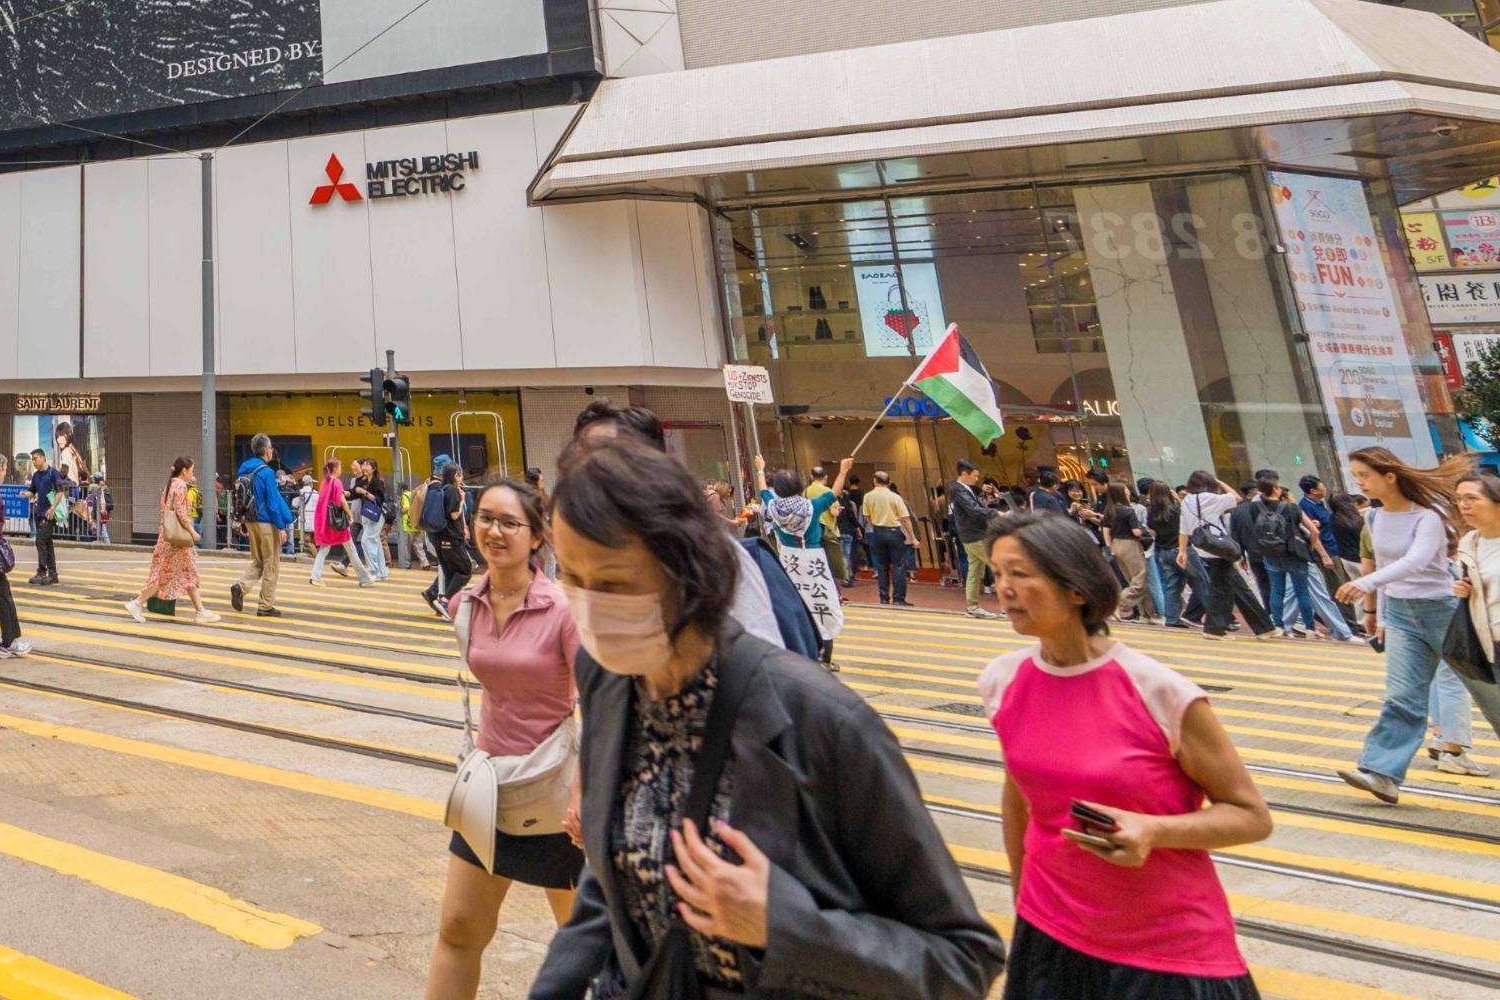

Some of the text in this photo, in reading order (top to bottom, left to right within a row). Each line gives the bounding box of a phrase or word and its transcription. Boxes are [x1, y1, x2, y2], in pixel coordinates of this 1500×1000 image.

[166, 39, 319, 80] DESIGNED BY
[366, 151, 480, 181] MITSUBISHI
[368, 173, 467, 200] ELECTRIC
[1316, 264, 1355, 287] FUN
[1420, 282, 1500, 302] 園餐
[738, 381, 758, 391] STOP
[16, 397, 100, 411] SAINT LAURENT
[883, 396, 951, 417] SOG
[384, 415, 434, 427] PRIS
